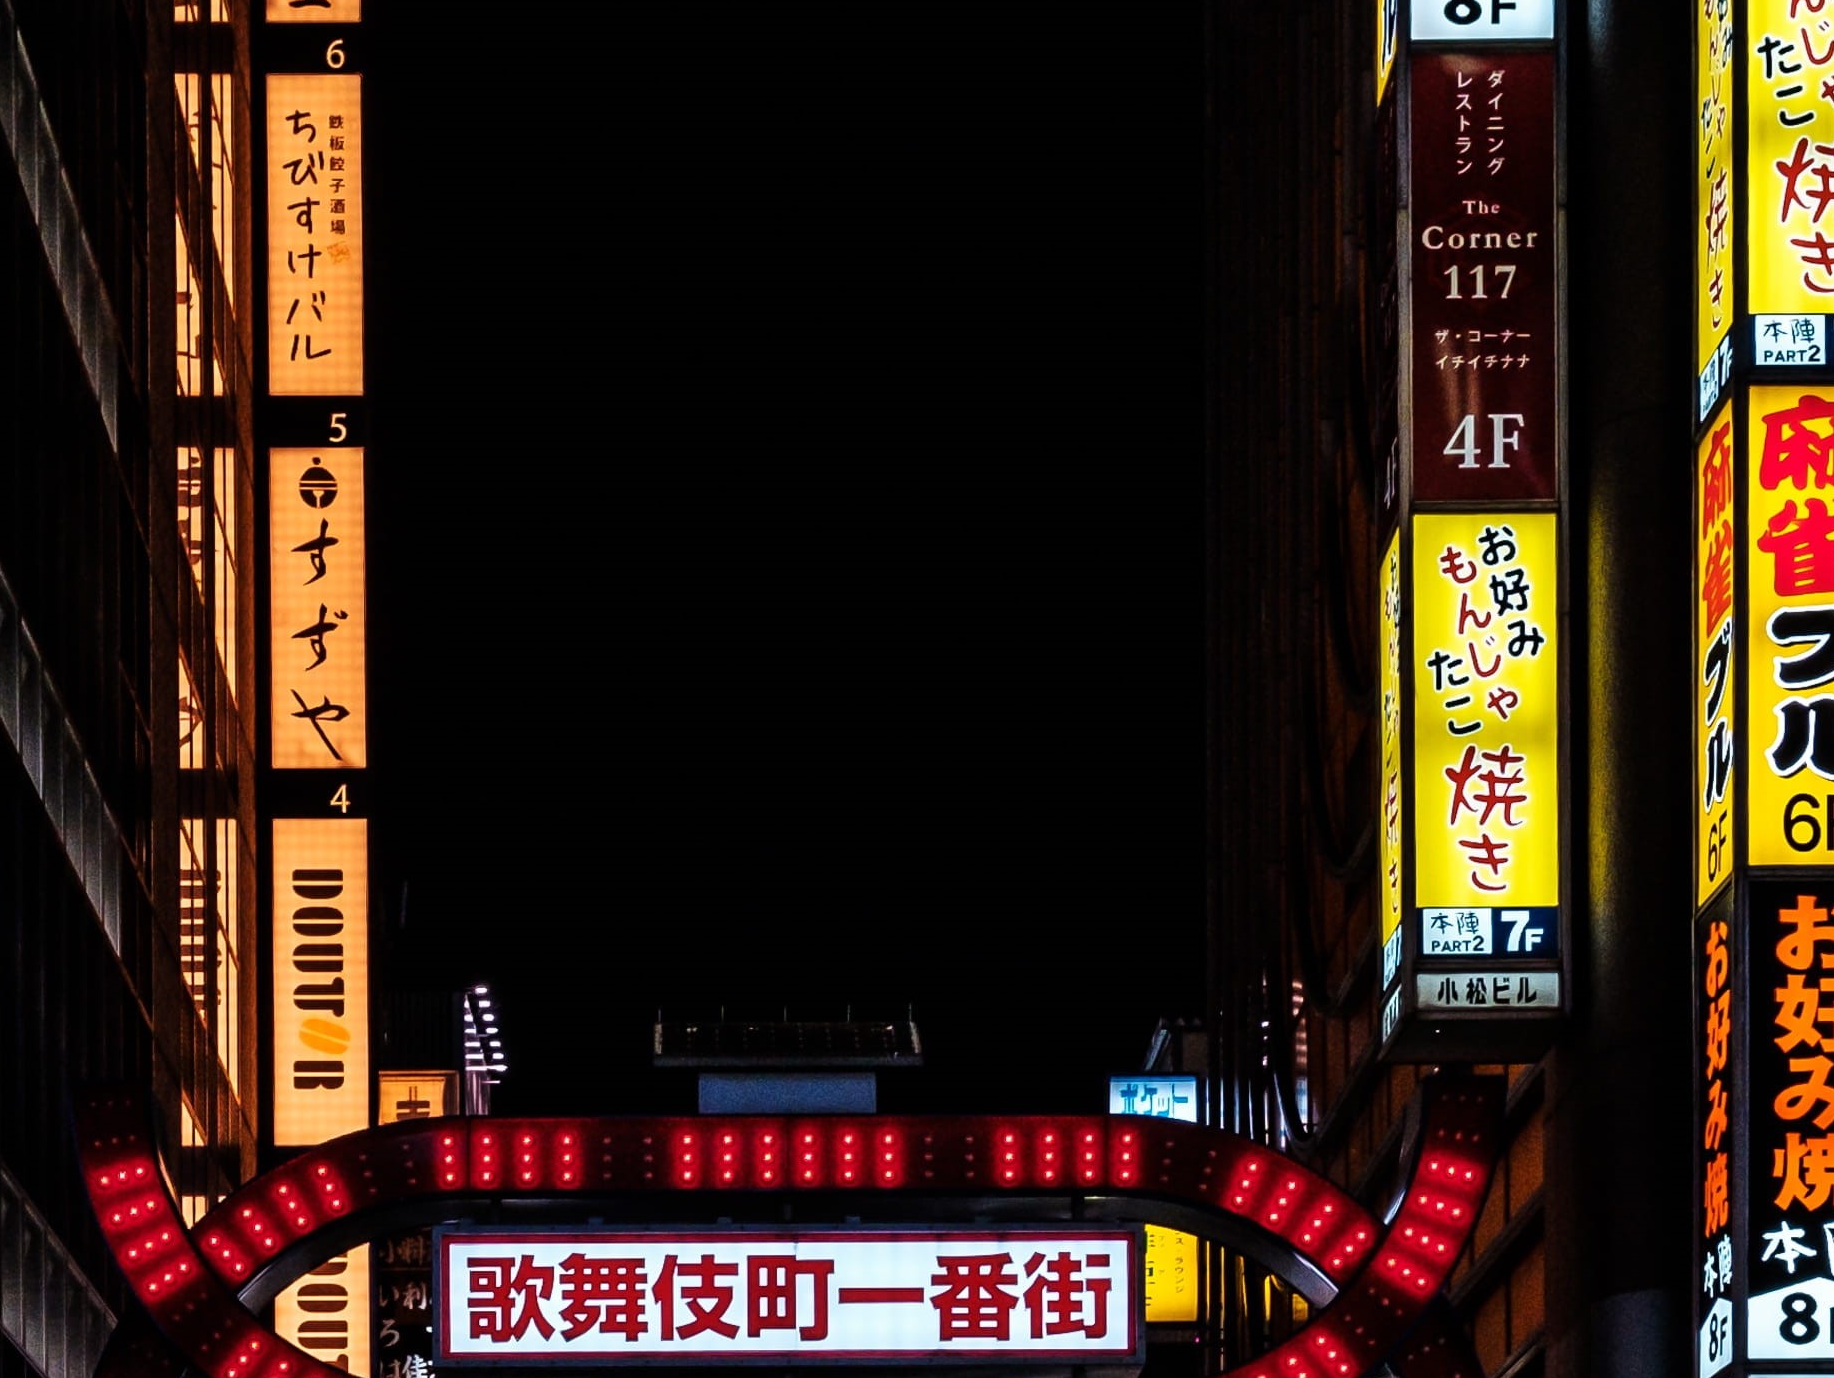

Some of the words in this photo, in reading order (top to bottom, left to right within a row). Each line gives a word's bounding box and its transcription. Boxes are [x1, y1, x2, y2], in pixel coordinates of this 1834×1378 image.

[325, 40, 346, 70] 6
[1455, 70, 1473, 176] レストラン
[1487, 70, 1506, 176] ダイニング
[1462, 200, 1500, 215] The
[282, 109, 332, 363] ちびすけバル
[1421, 226, 1539, 251] Corner
[1443, 264, 1517, 300] 117
[1434, 354, 1531, 370] イチイチナナ
[1763, 345, 1822, 364] PART2
[329, 413, 349, 442] 5
[1442, 414, 1525, 469] 4F
[290, 517, 350, 761] すずや
[330, 784, 351, 814] 4
[1444, 743, 1528, 892] 焼き
[1500, 910, 1544, 953] 7F
[467, 1252, 1113, 1342] 歌舞伎町一番街
